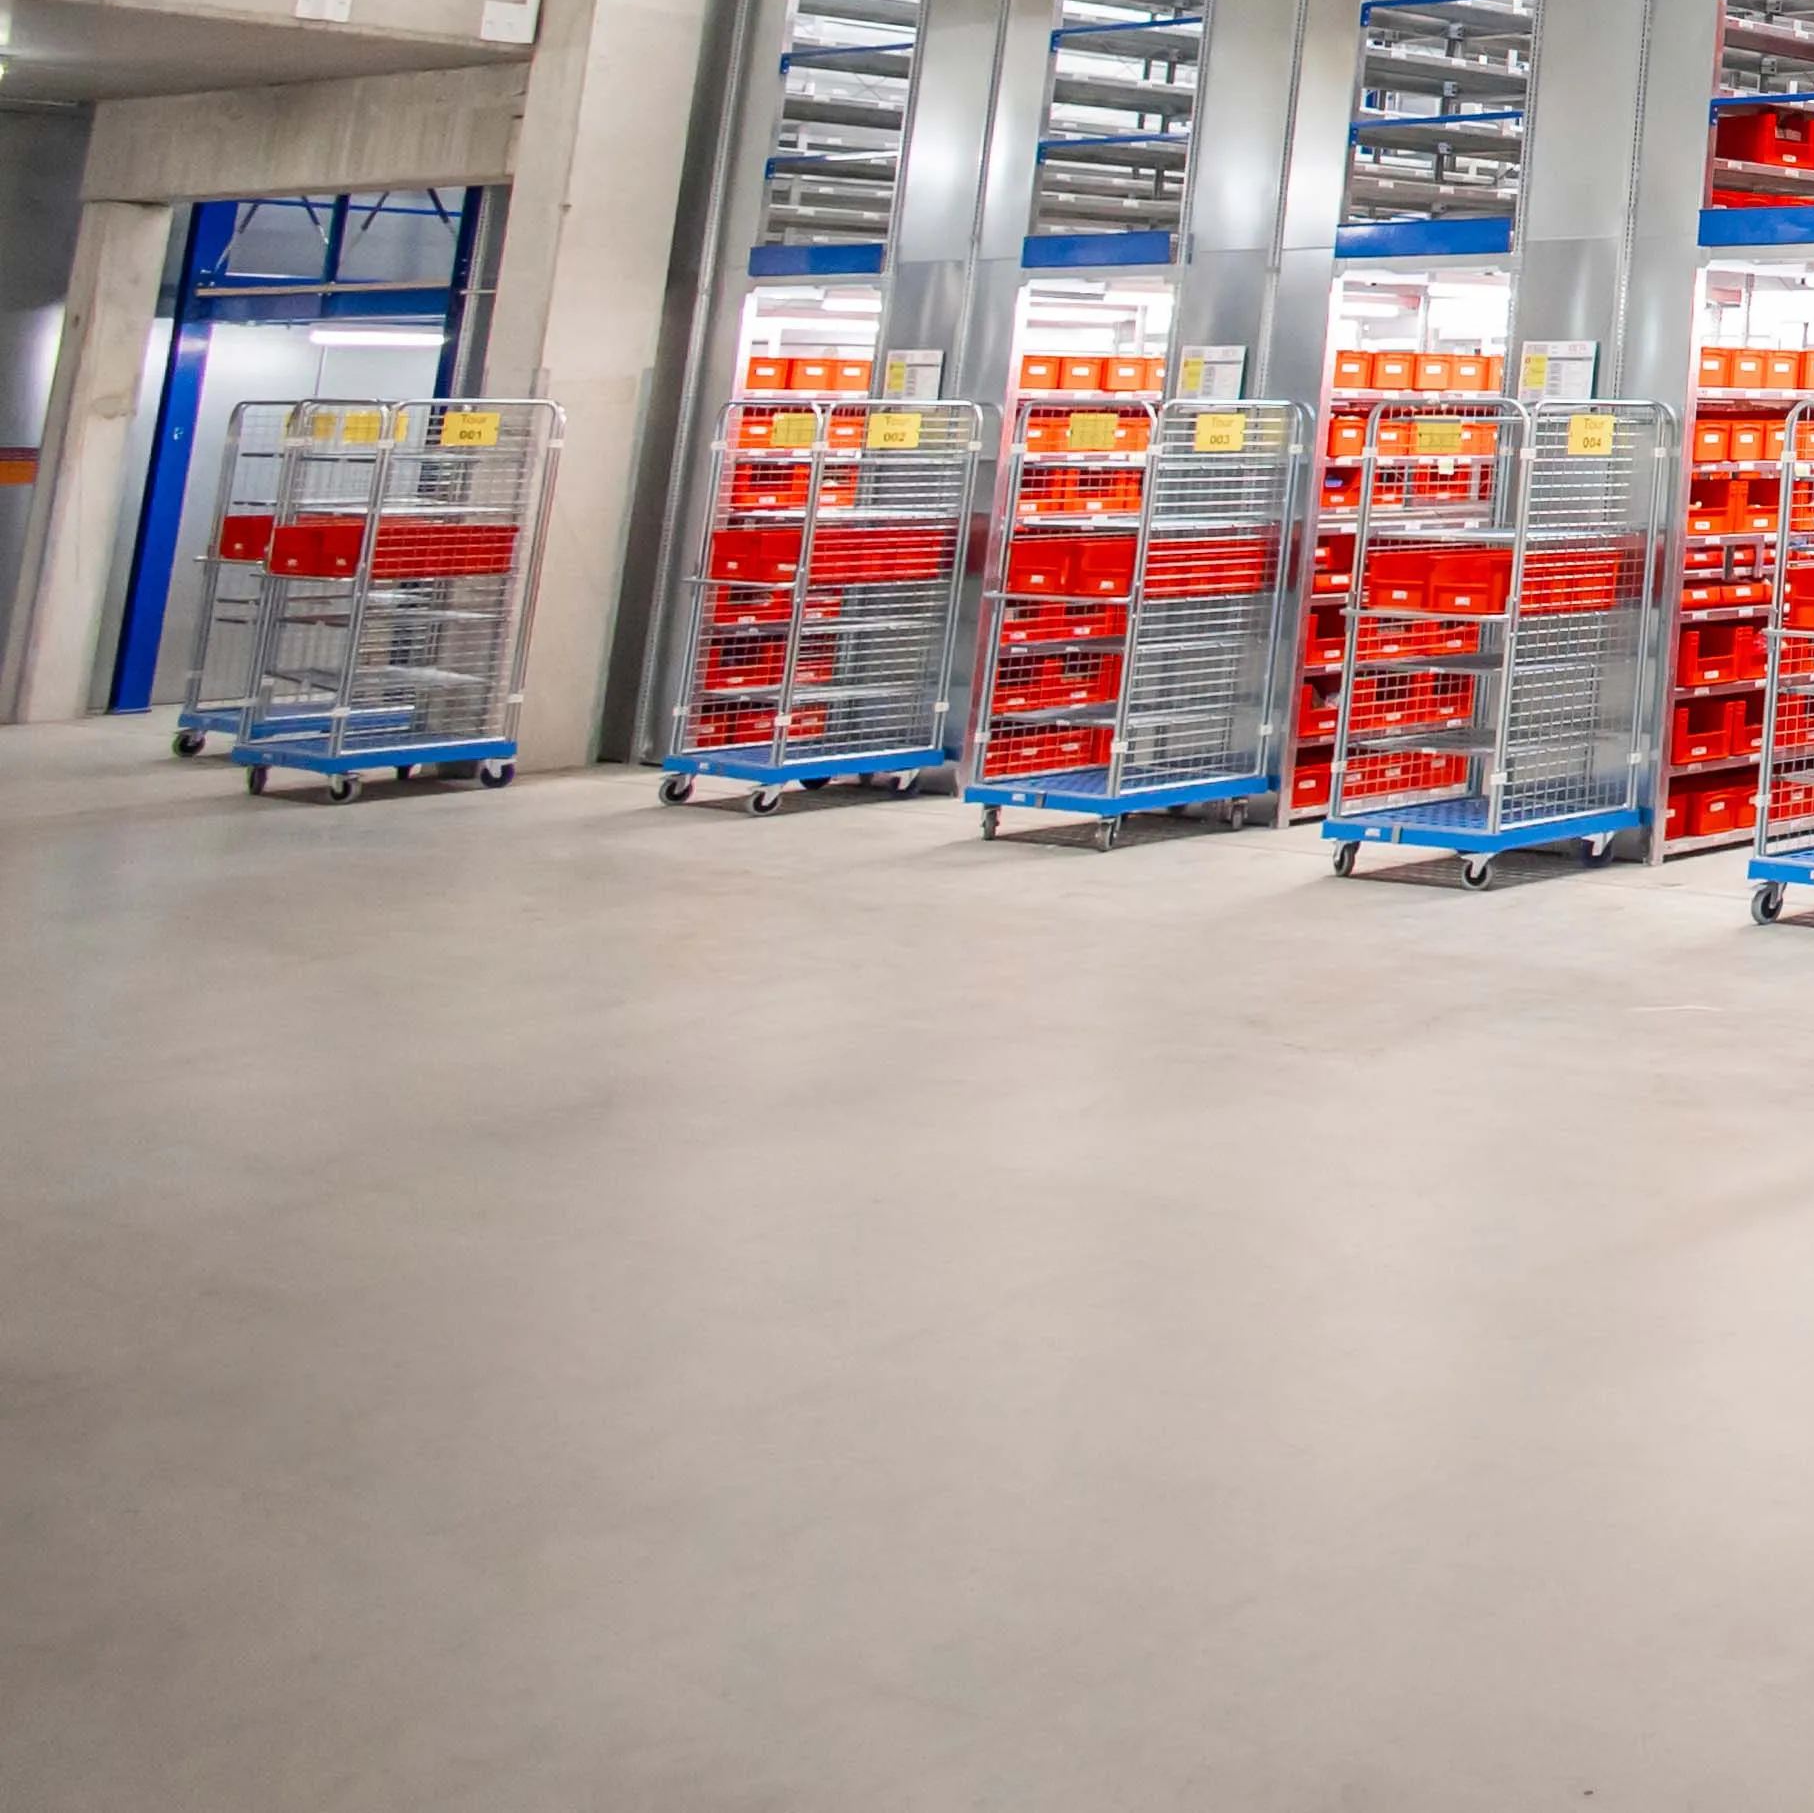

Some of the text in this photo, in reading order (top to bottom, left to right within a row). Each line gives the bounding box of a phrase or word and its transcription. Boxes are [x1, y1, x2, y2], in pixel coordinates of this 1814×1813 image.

[459, 430, 482, 440] 001
[883, 431, 907, 442] 002
[1582, 436, 1602, 449] 004
